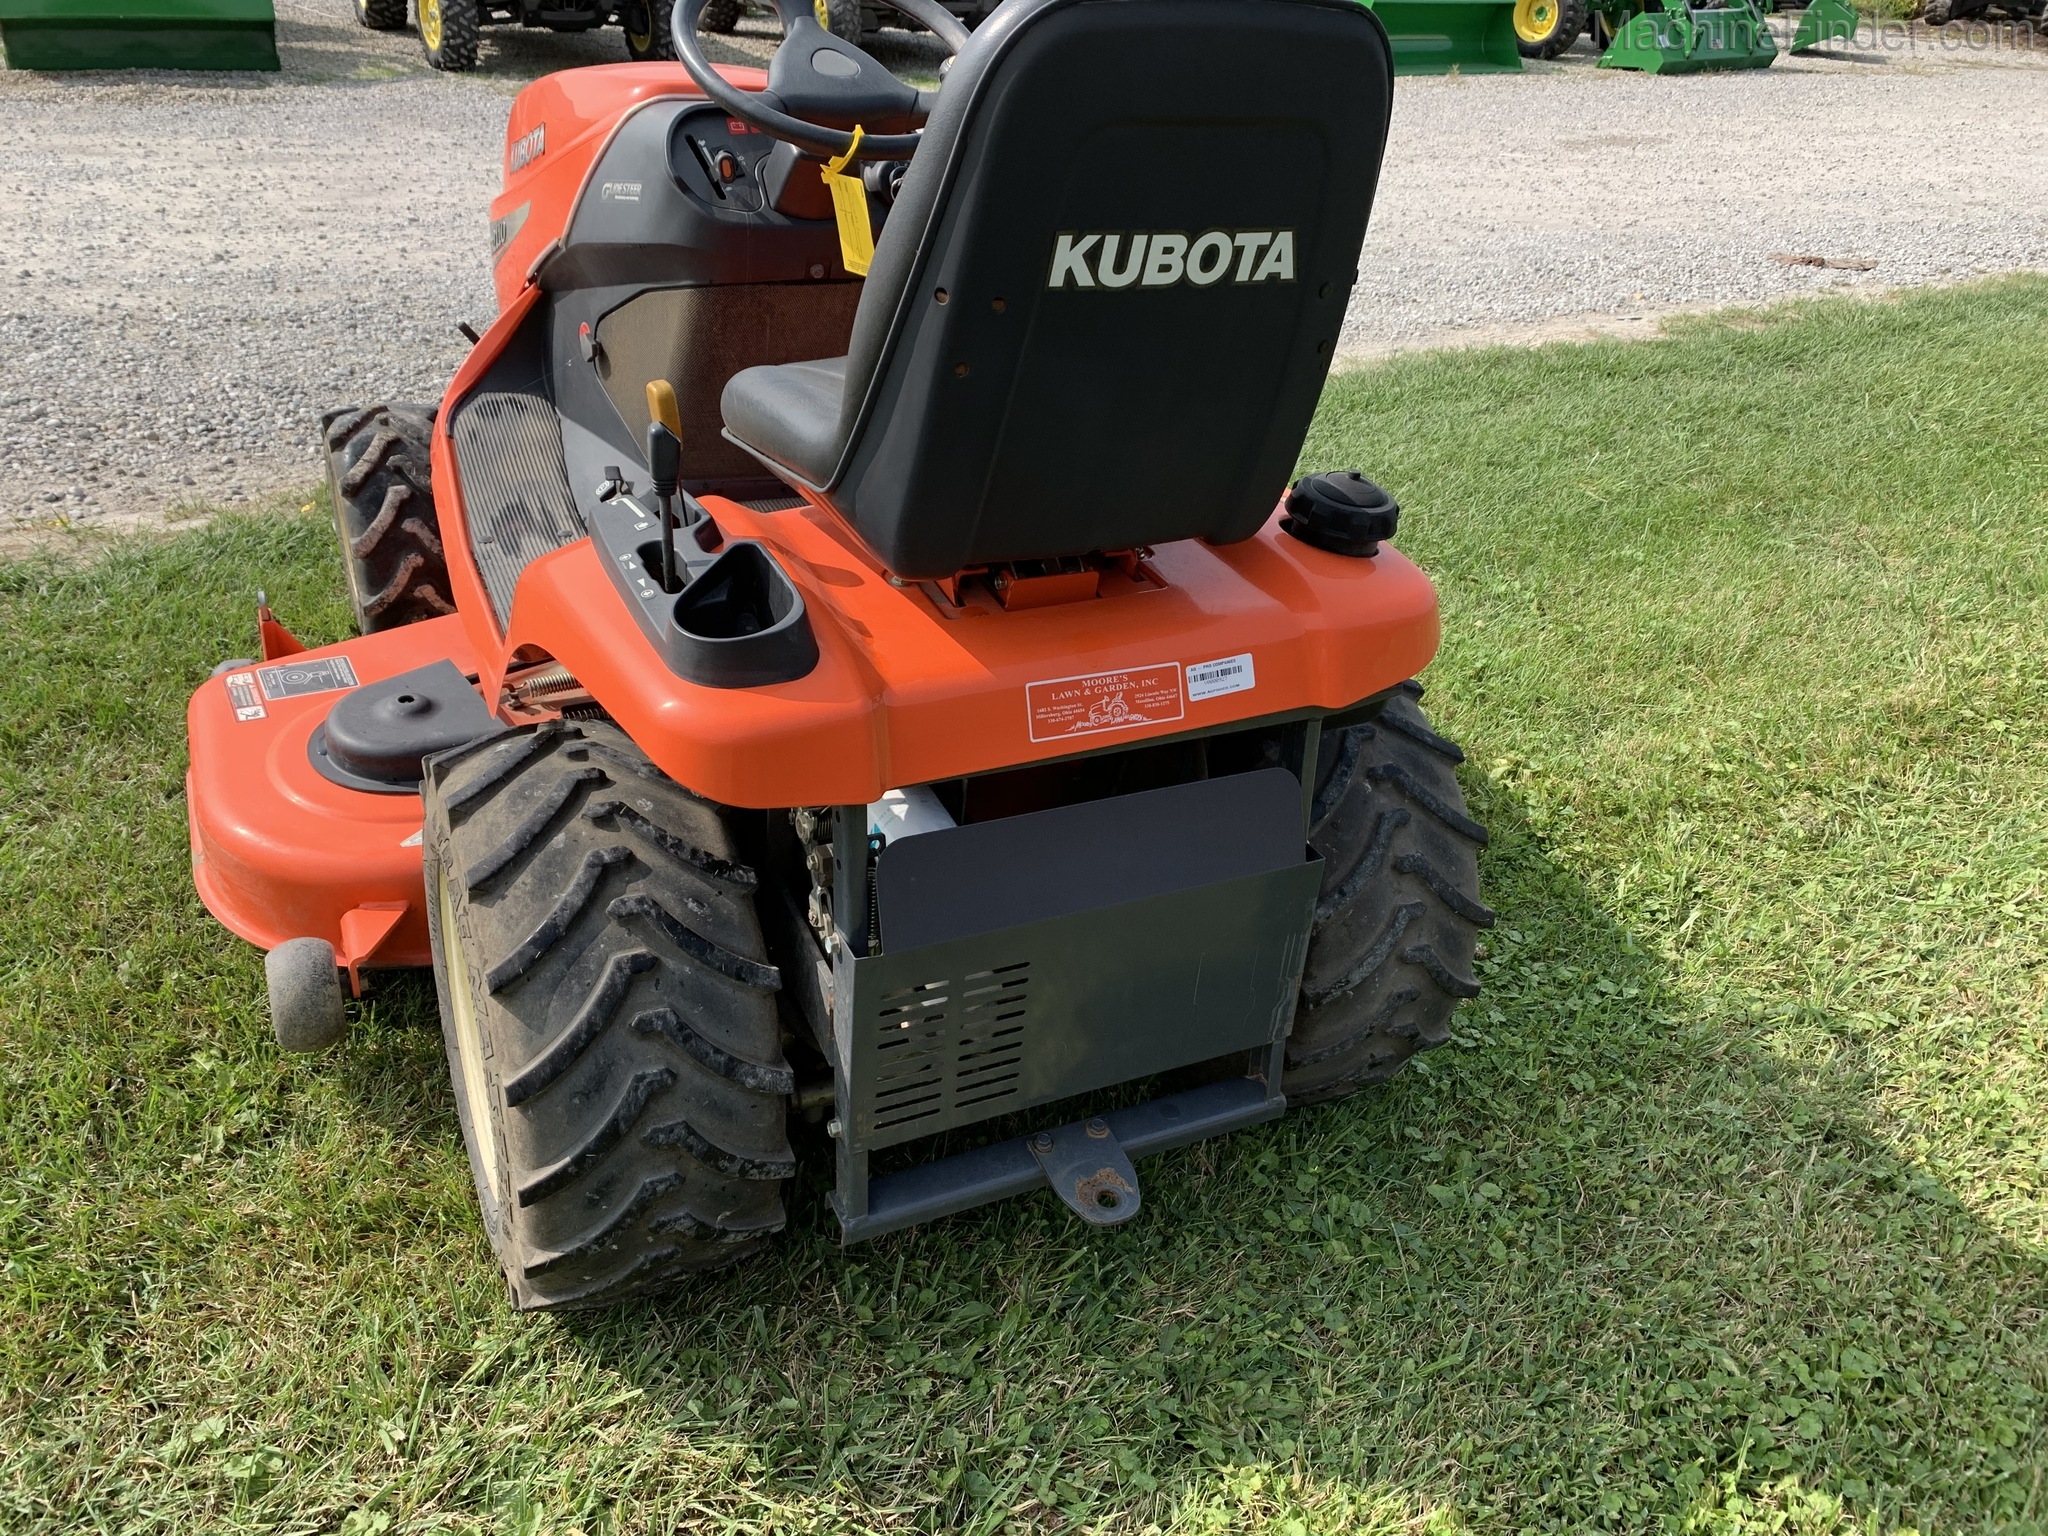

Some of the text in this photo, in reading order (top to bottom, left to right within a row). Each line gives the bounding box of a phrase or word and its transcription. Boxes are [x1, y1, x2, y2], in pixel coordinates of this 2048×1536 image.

[510, 123, 545, 173] KUBOTA
[1048, 231, 1294, 288] KUBOTA
[1051, 678, 1159, 700] LAWN & GARDEN, INC
[1082, 674, 1128, 688] MOORE'S
